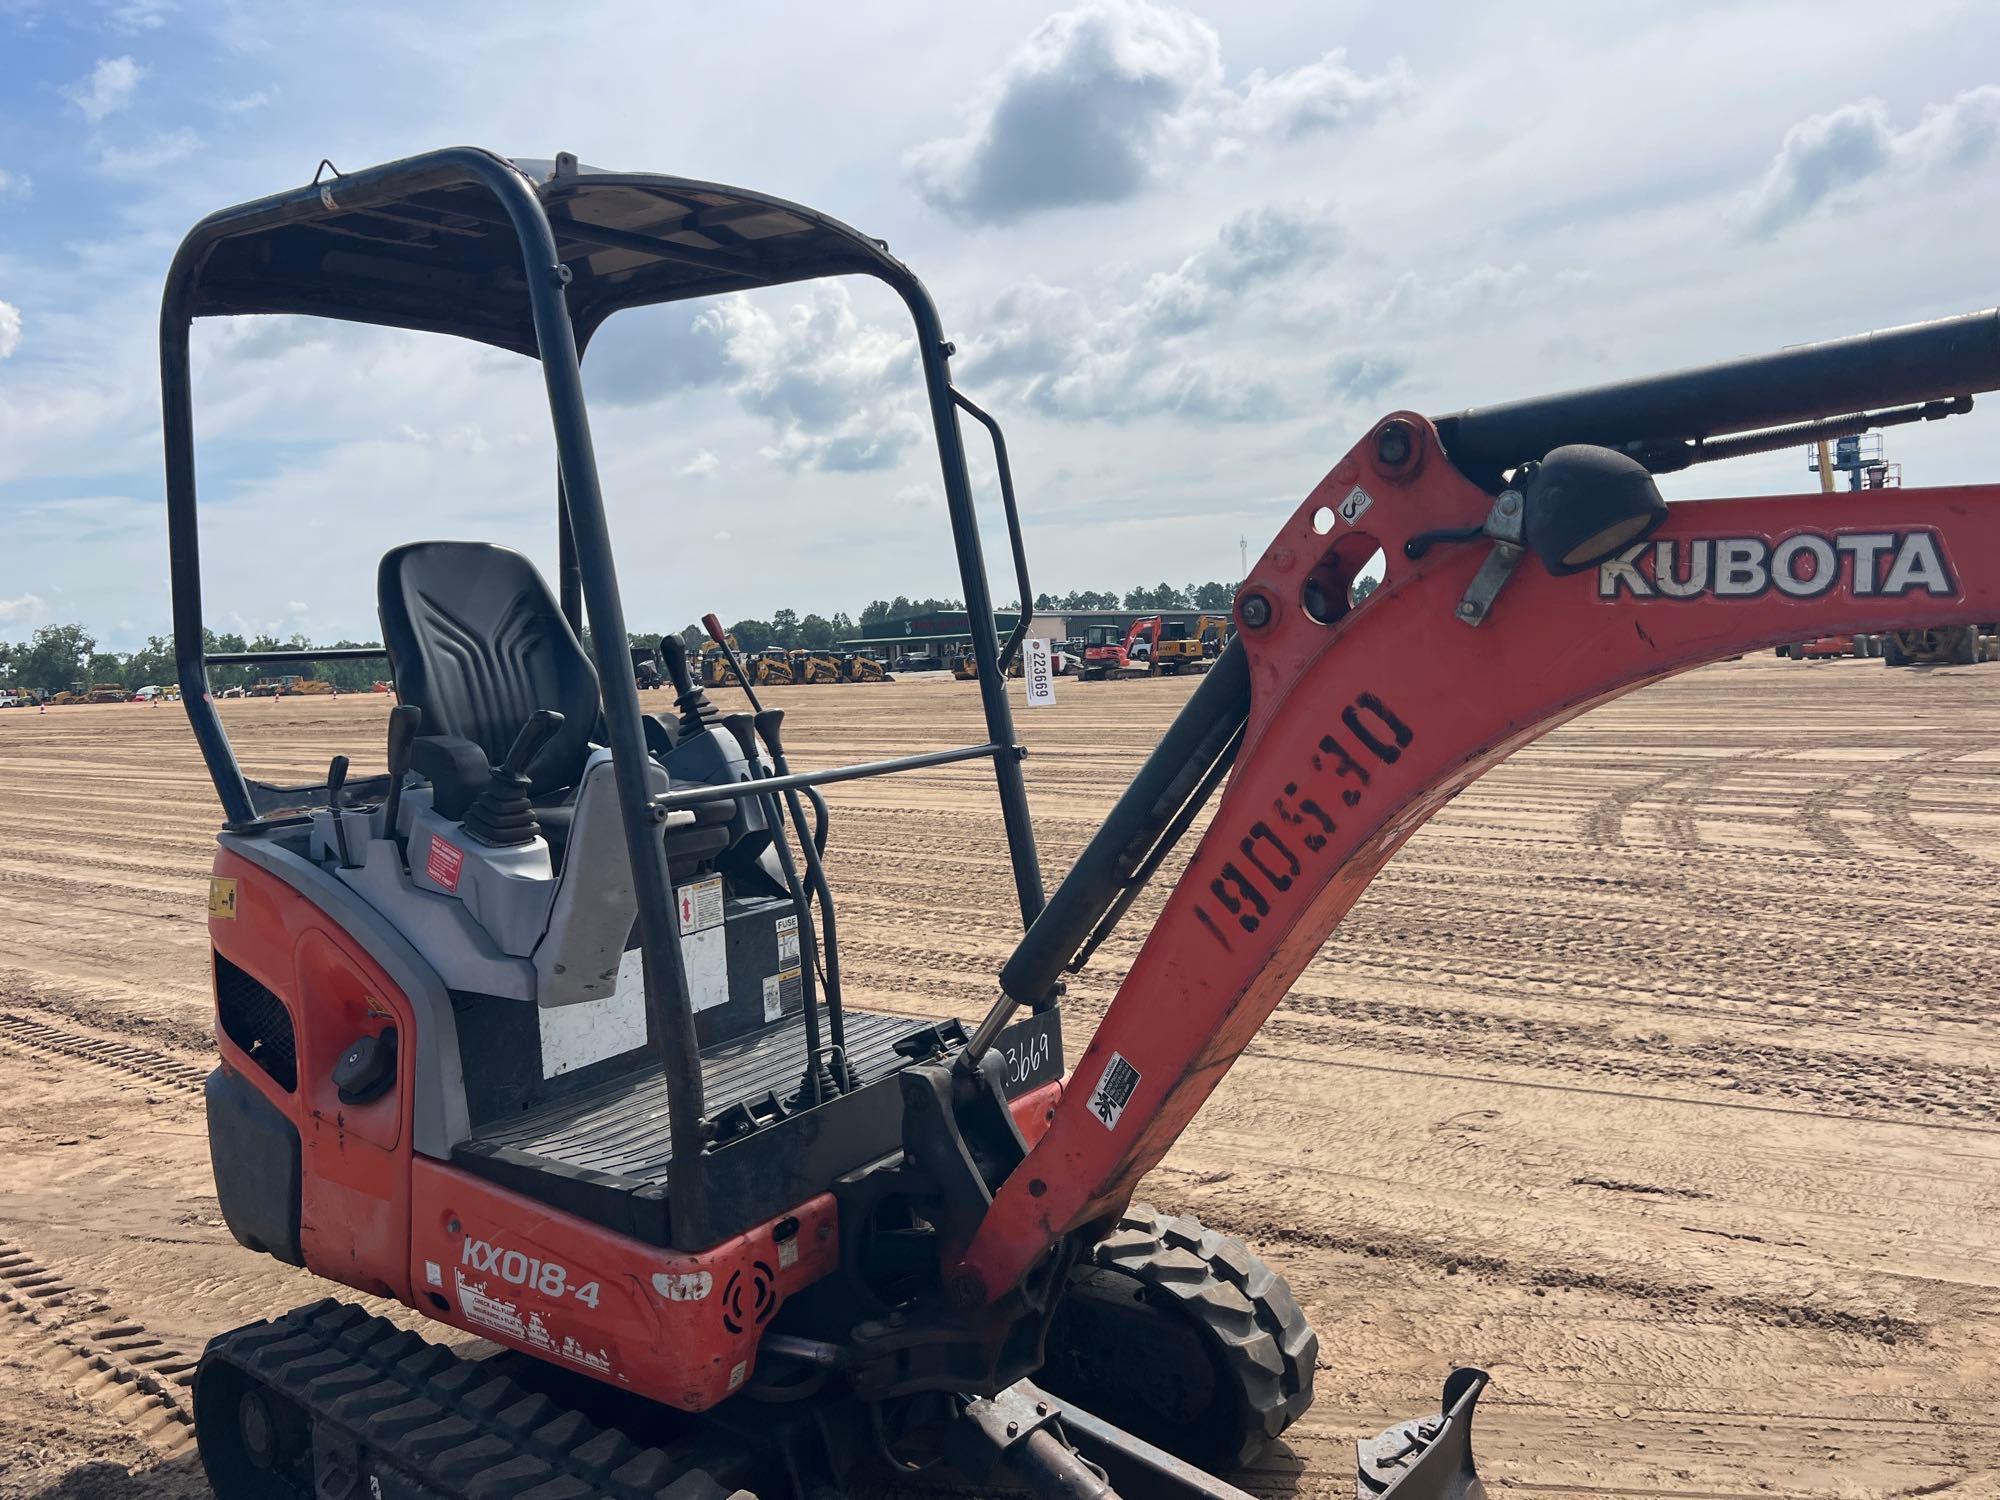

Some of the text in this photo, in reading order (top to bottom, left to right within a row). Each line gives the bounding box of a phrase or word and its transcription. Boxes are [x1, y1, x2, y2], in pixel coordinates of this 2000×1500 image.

[1599, 531, 1953, 598] KUBOTA
[1033, 652, 1049, 697] 223669
[777, 917, 797, 929] FUSE
[1005, 1032, 1049, 1087] 3669
[461, 1237, 600, 1309] KX018-4
[473, 1296, 490, 1307] CHECK
